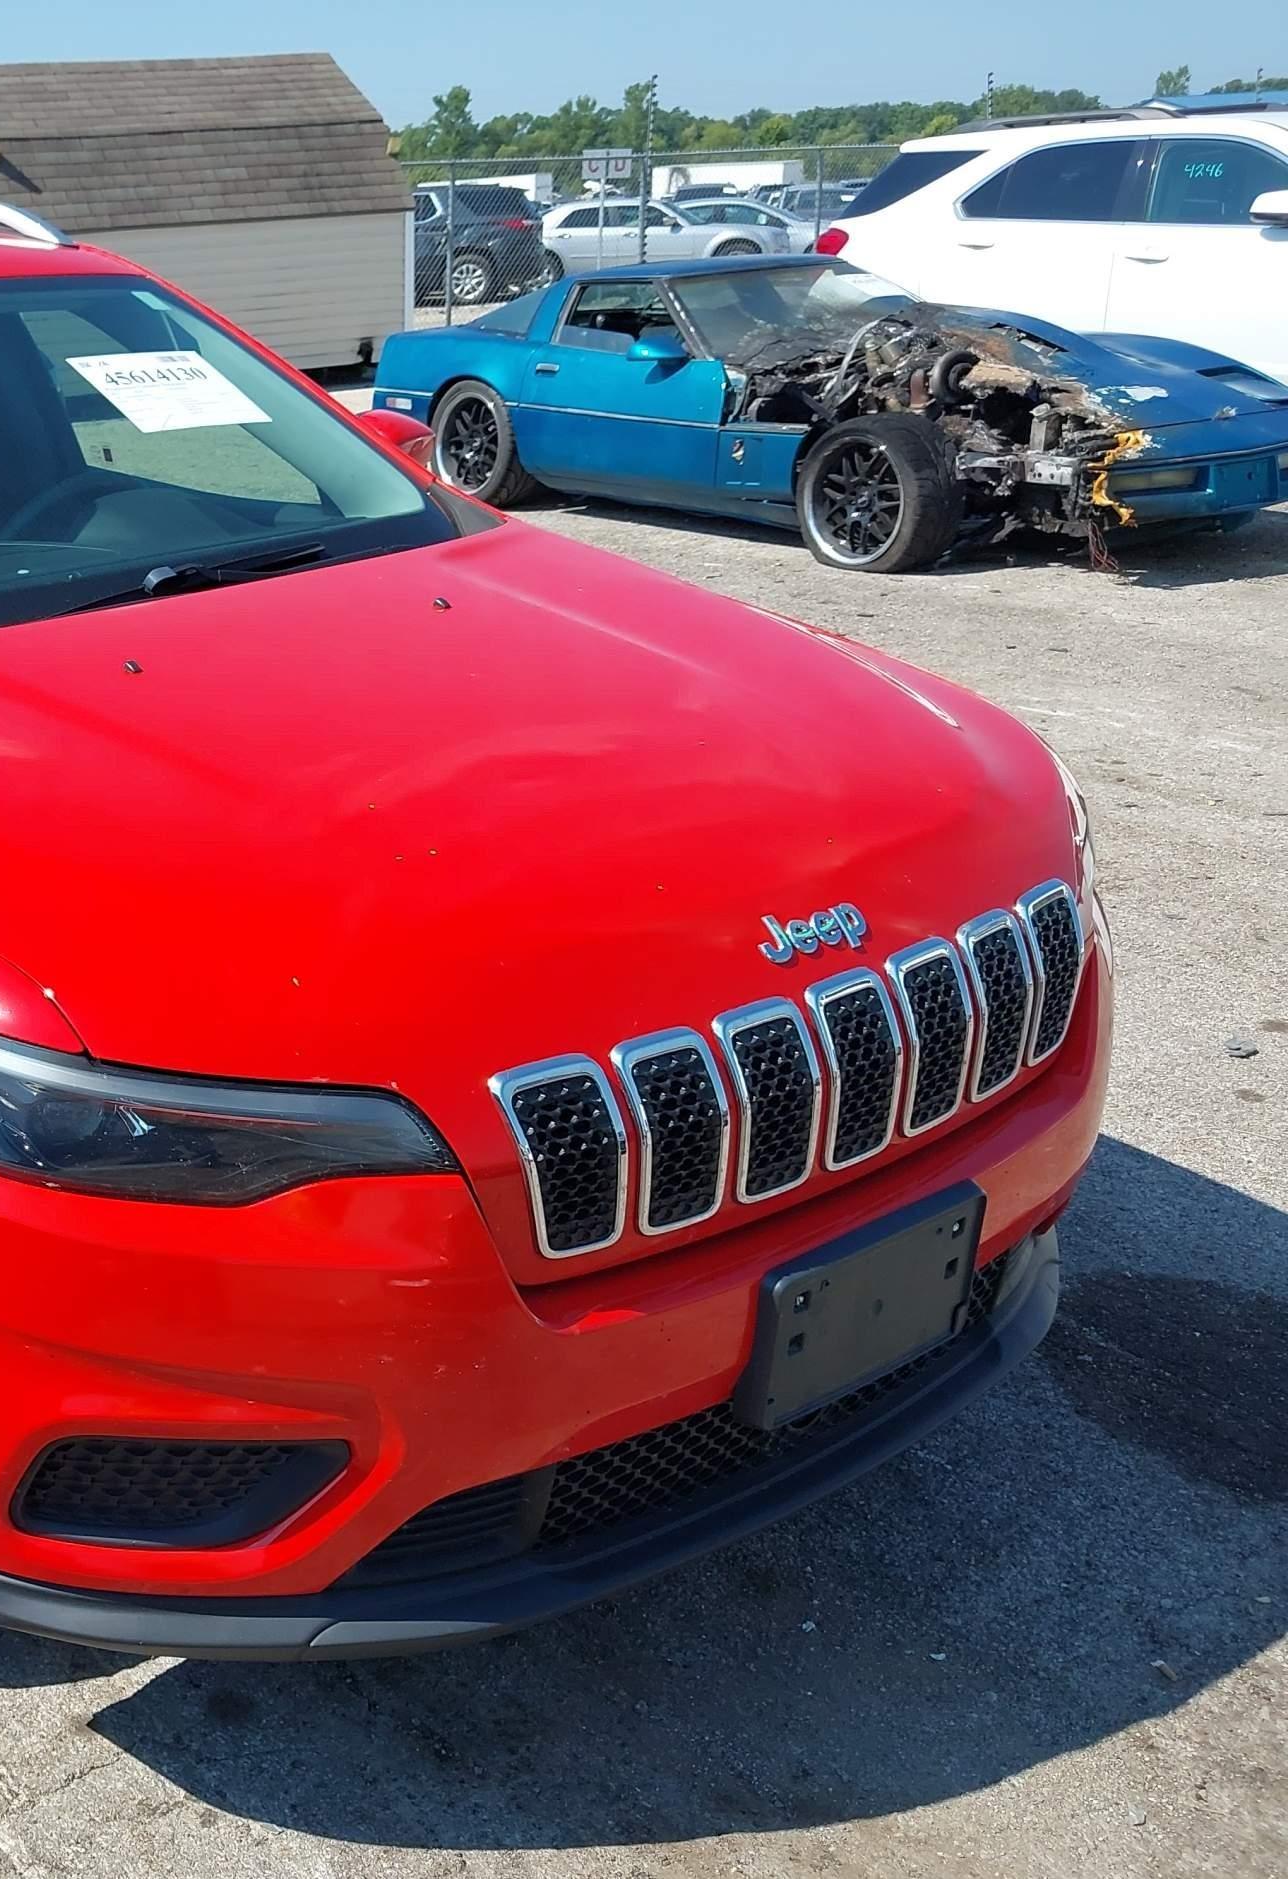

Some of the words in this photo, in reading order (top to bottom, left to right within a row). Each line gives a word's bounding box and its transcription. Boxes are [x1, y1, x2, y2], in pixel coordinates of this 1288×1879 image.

[1184, 162, 1224, 179] 4246
[104, 366, 208, 386] 45614130
[757, 902, 867, 963] Jeep
